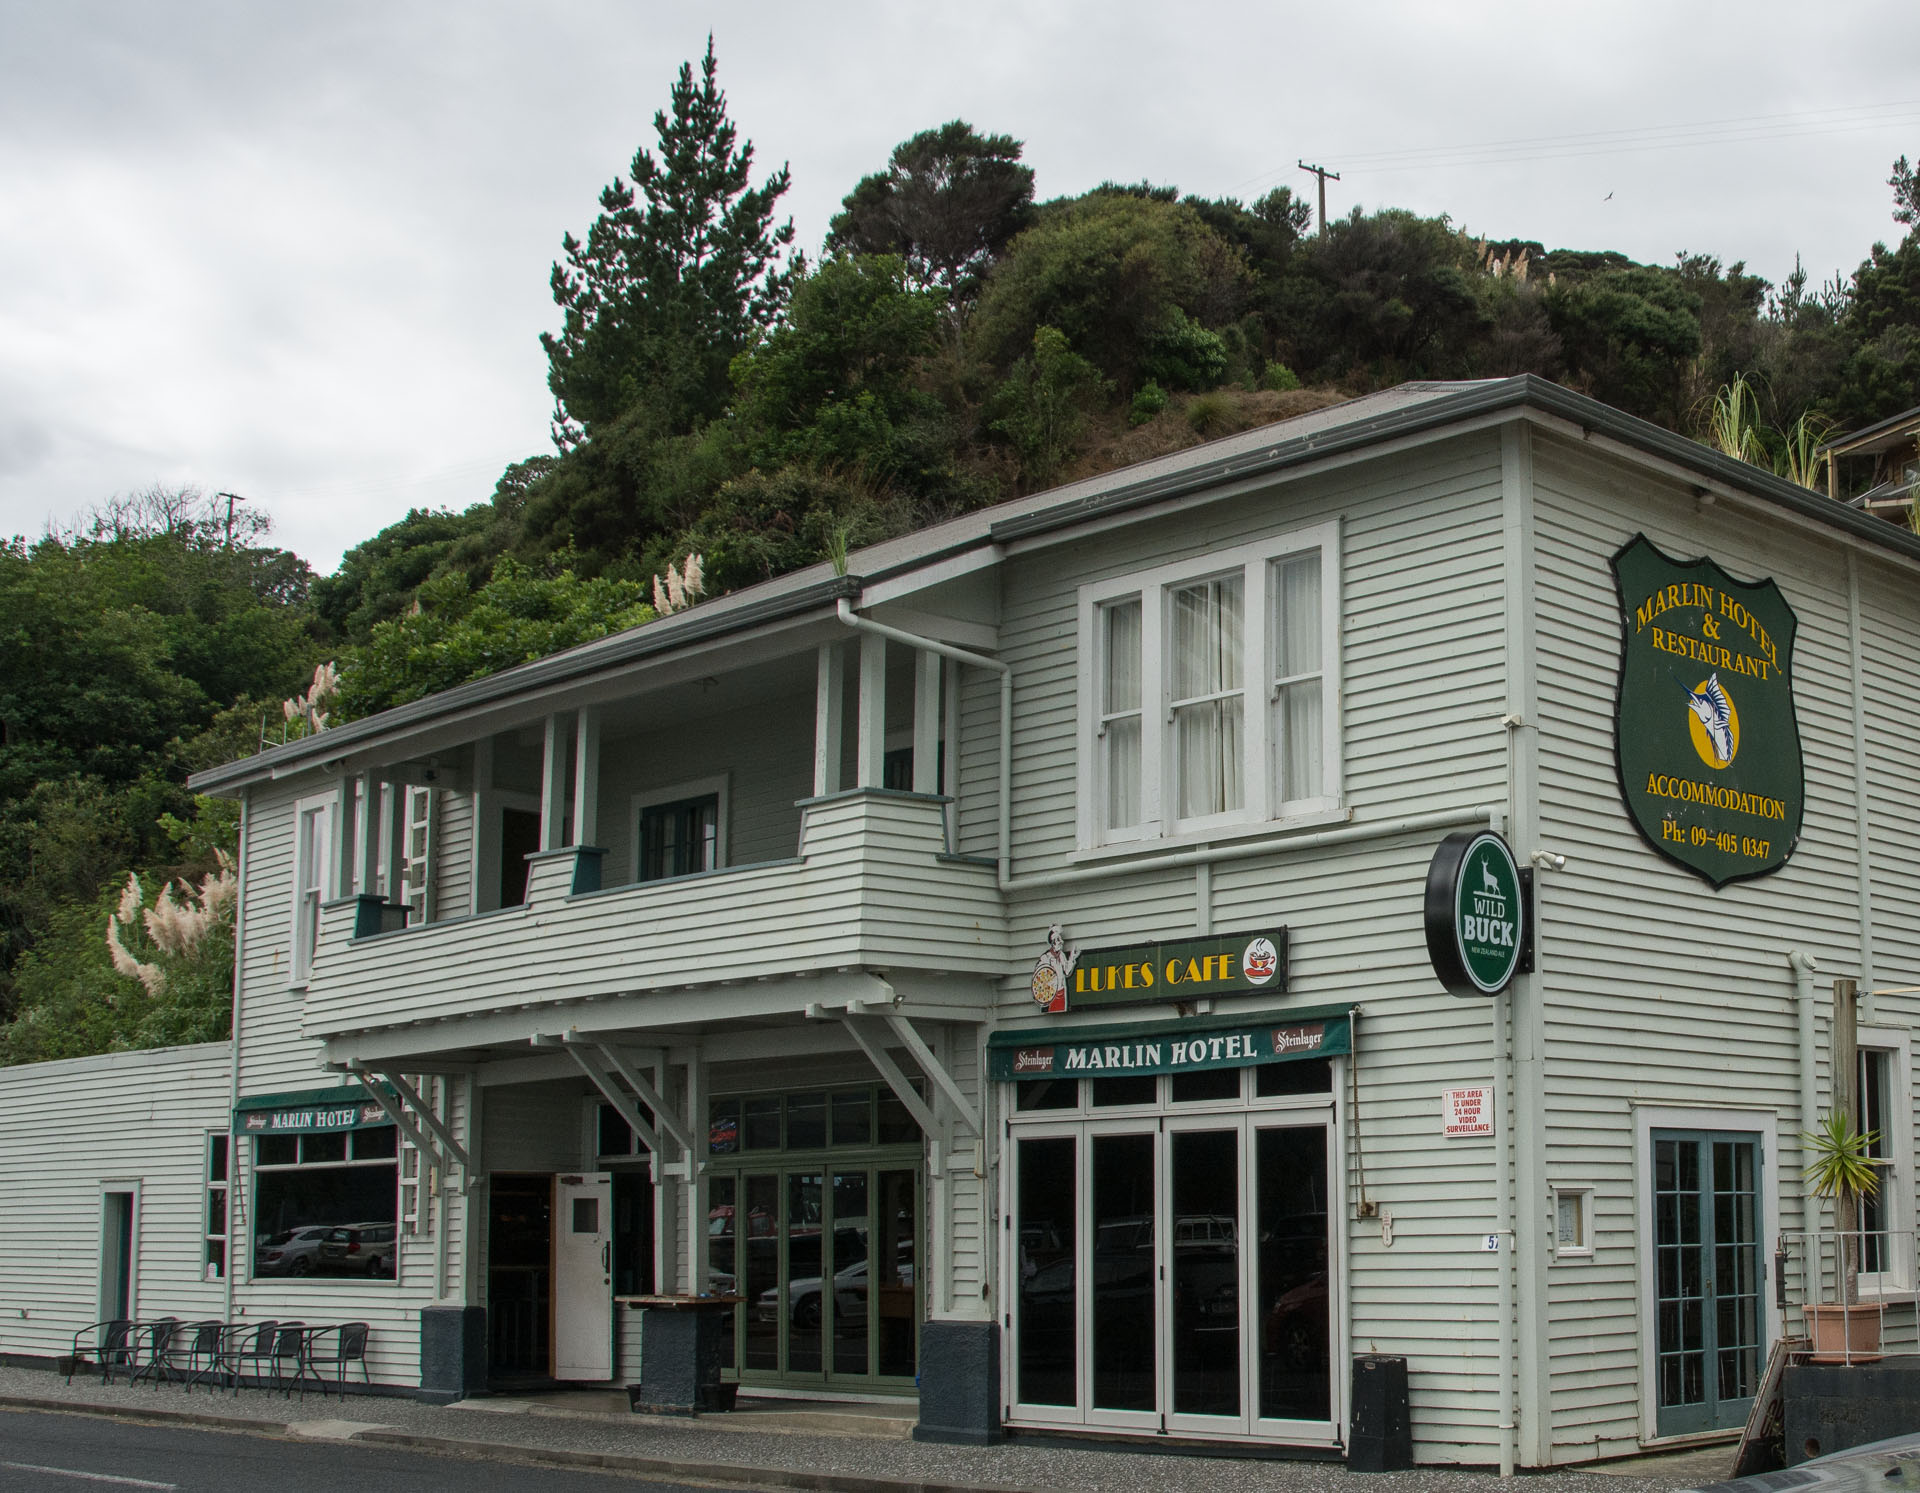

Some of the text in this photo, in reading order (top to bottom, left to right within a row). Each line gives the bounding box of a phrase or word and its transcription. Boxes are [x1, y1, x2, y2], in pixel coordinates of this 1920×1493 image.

[1636, 583, 1782, 675] MARLIN HOTEL
[1702, 613, 1721, 640] &
[1652, 626, 1770, 681] RESTAURANT
[1646, 773, 1785, 821] ACCOMMODATION
[1662, 820, 1770, 859] Ph: 09-405 0347
[1474, 898, 1506, 919] WILD
[1463, 914, 1514, 947] BUCK
[1075, 953, 1235, 993] LUKES CAFE
[1064, 1034, 1258, 1070] MARLIN HOTEL
[1275, 1028, 1323, 1053] Steinlager
[1015, 1050, 1054, 1070] Steinlager
[1452, 1090, 1482, 1099] THIS AREA
[1461, 1099, 1481, 1107] UNDER
[271, 1111, 313, 1129] MARLIN
[315, 1108, 356, 1127] HOTEL
[1454, 1107, 1481, 1116] 24 HOUR
[1458, 1116, 1477, 1124] VIDEO
[1446, 1123, 1489, 1133] SURVEILLANCE
